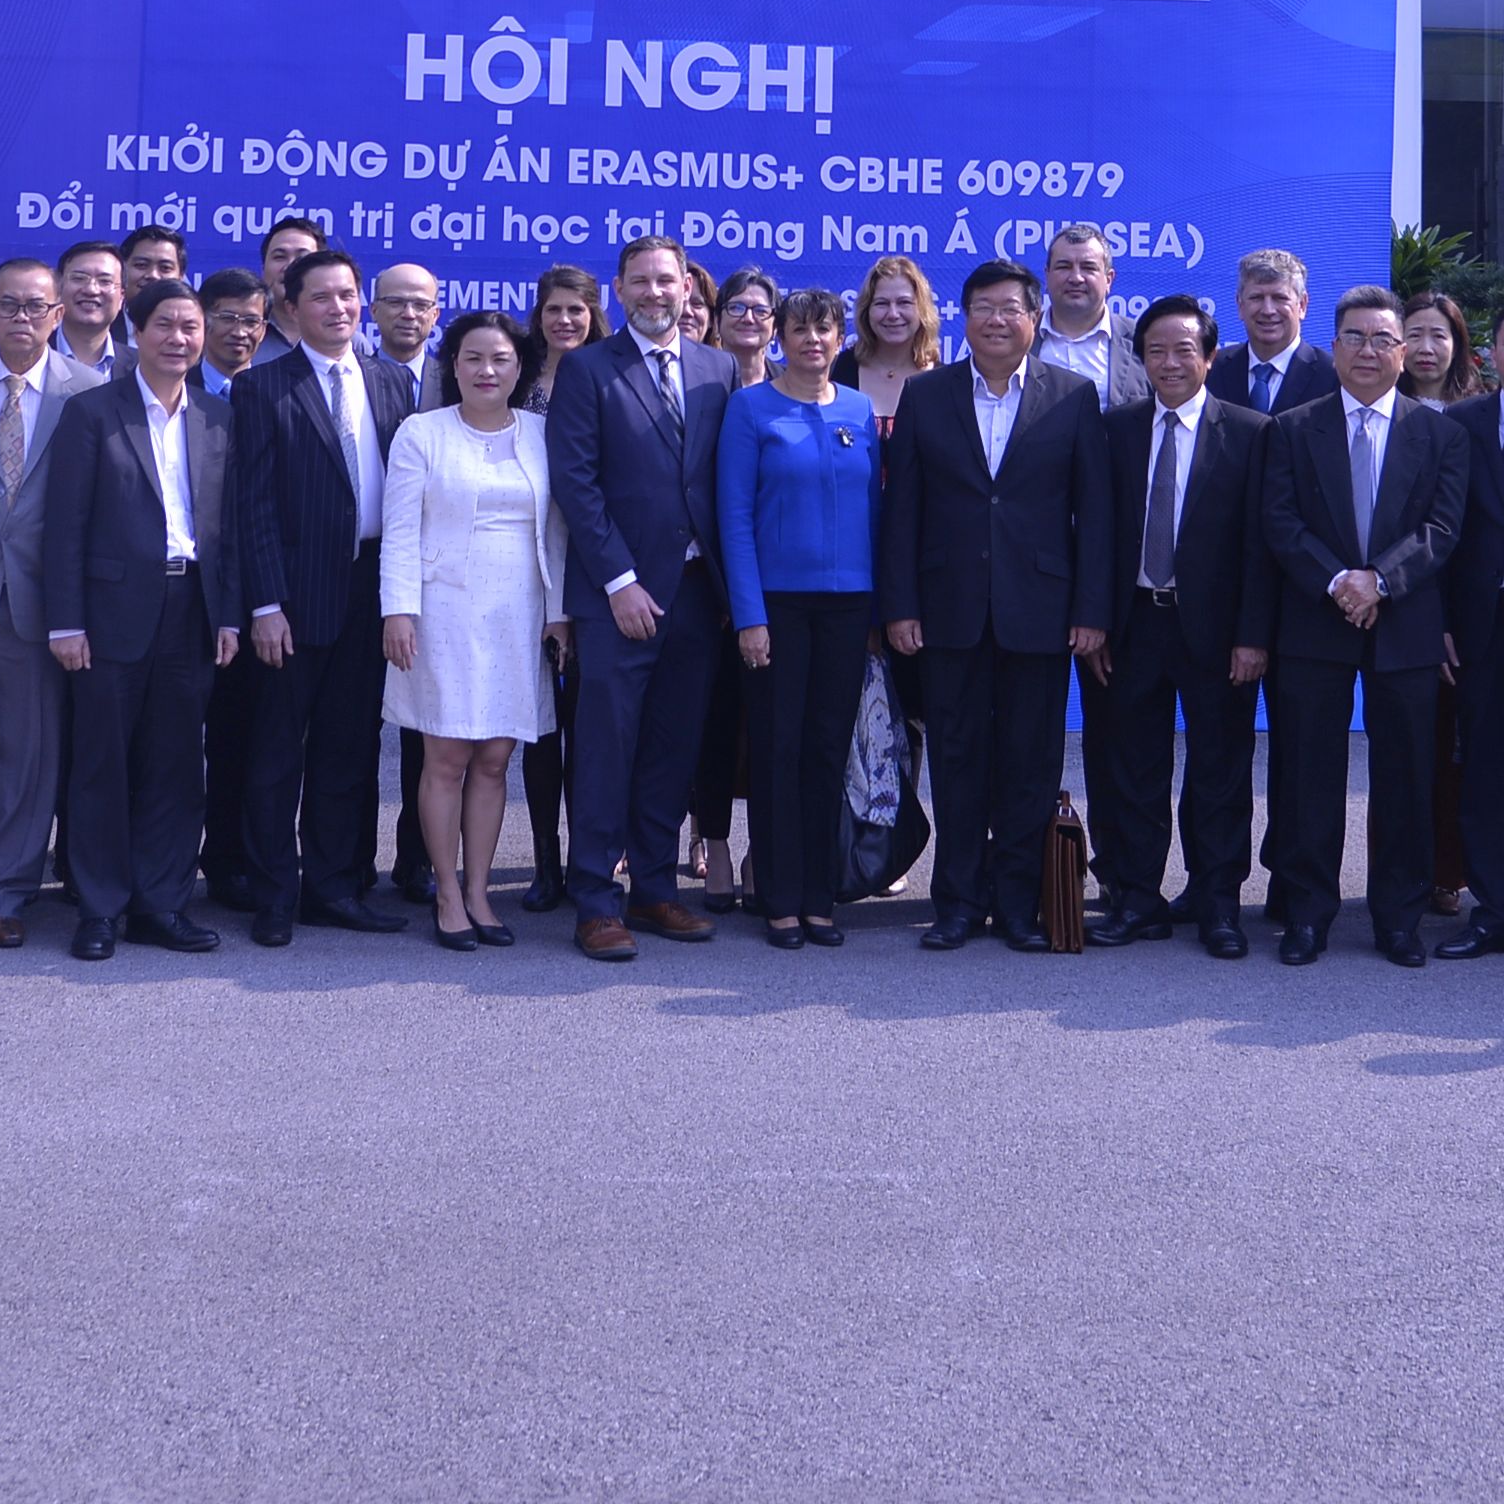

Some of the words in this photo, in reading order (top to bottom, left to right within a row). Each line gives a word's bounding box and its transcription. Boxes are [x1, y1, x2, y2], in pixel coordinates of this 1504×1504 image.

[405, 15, 568, 125] HỘI
[604, 39, 834, 135] NGHỊ
[106, 122, 224, 174] KHỞI
[240, 129, 389, 187] ĐỘNG
[403, 139, 472, 191] DỰ
[482, 134, 551, 184] ÁN
[567, 147, 804, 191] ERASMUS+
[819, 154, 943, 195] CBHE
[958, 159, 1125, 198] 609879
[16, 180, 95, 231] Đổi
[110, 192, 197, 233] mới
[350, 200, 394, 249] trị
[410, 203, 486, 251] đại
[502, 205, 591, 254] học
[680, 209, 805, 261] Đông
[821, 214, 929, 254] Nam
[943, 207, 978, 254] Á
